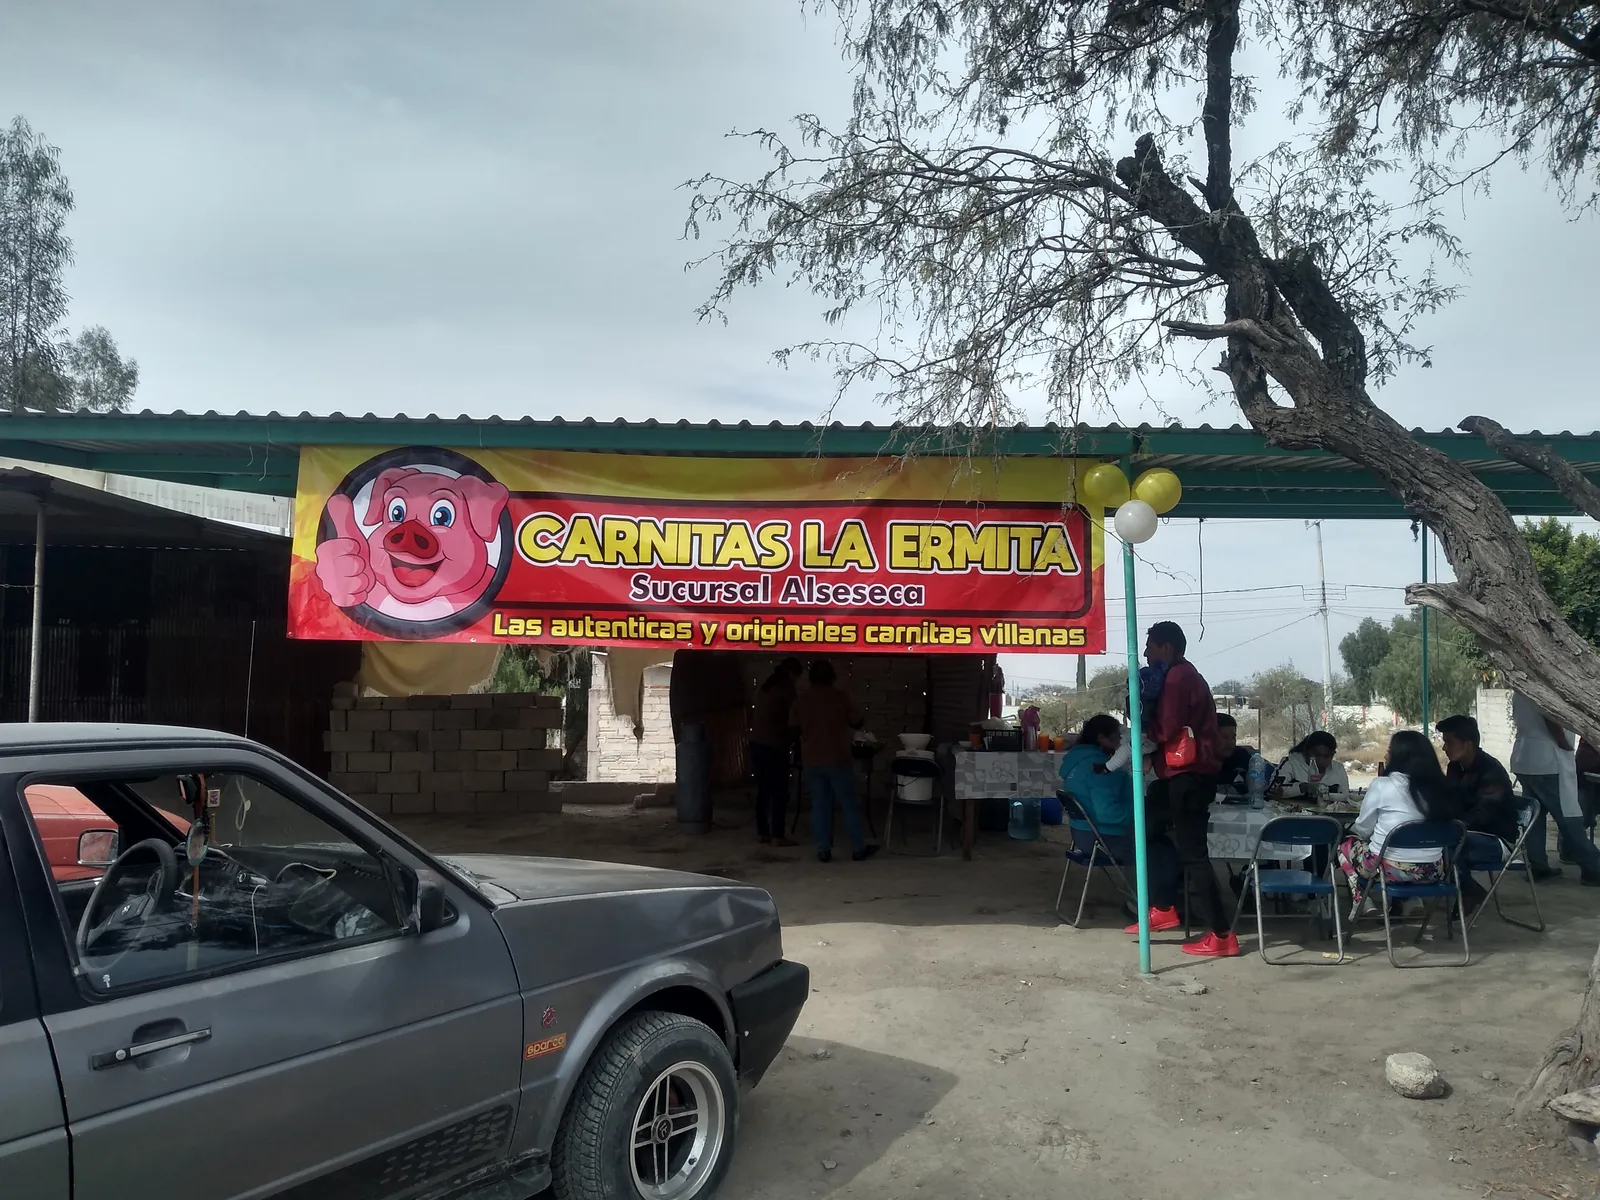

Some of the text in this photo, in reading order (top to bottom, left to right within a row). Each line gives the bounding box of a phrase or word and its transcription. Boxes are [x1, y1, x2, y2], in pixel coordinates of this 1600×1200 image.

[517, 513, 1081, 573] CARNITAS LA ERMITA
[631, 574, 924, 605] Sucursal Alseseca
[493, 613, 1086, 647] Las autenticas y originales carnitas villanas
